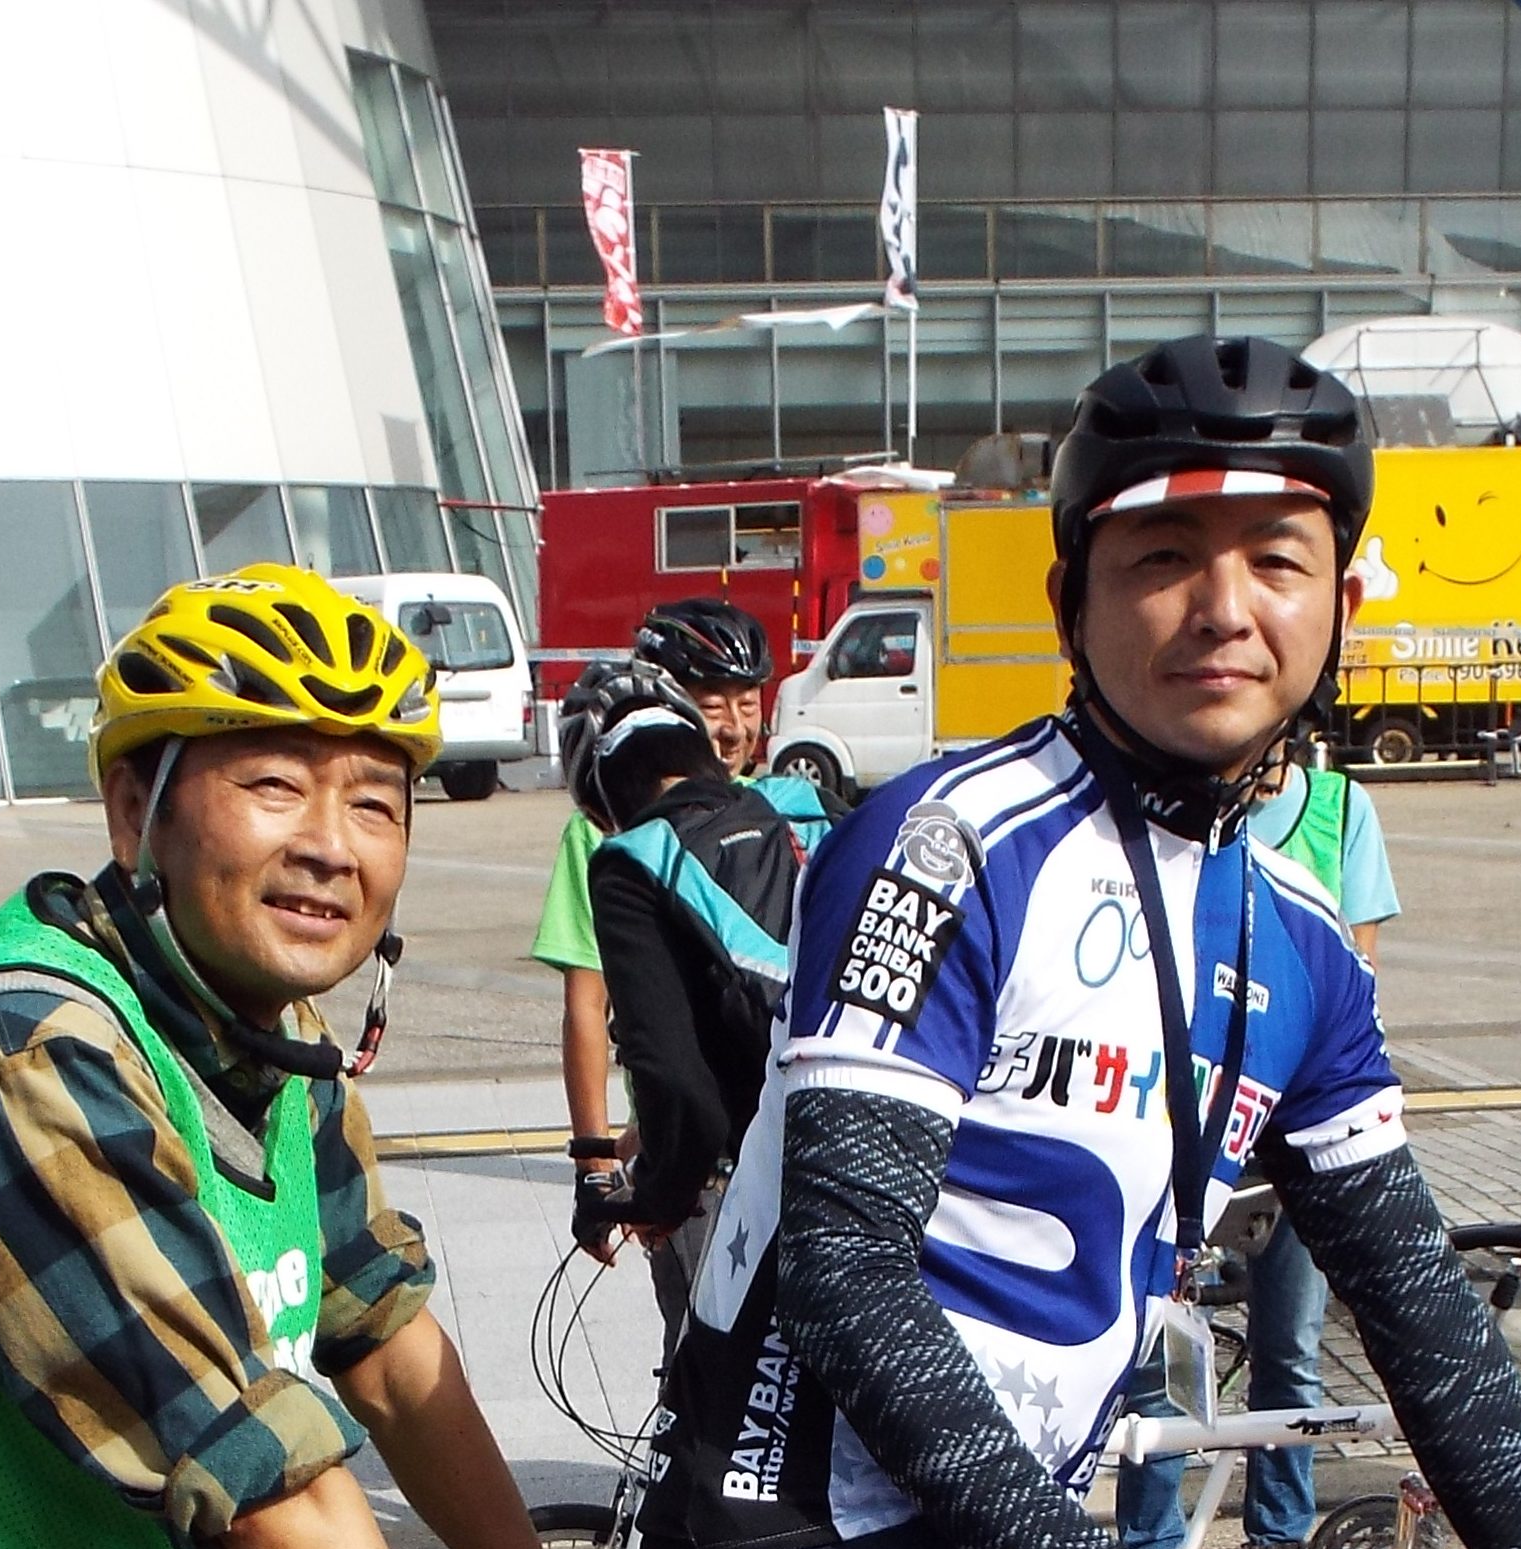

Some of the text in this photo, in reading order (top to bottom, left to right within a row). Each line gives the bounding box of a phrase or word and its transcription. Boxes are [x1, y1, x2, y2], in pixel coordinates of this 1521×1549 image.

[866, 878, 953, 937] BAY
[1091, 878, 1137, 899] KEIR
[851, 934, 924, 984] CHIBA
[857, 910, 936, 963] BANK
[839, 957, 917, 1012] 500
[722, 1306, 791, 1501] BAY BAN
